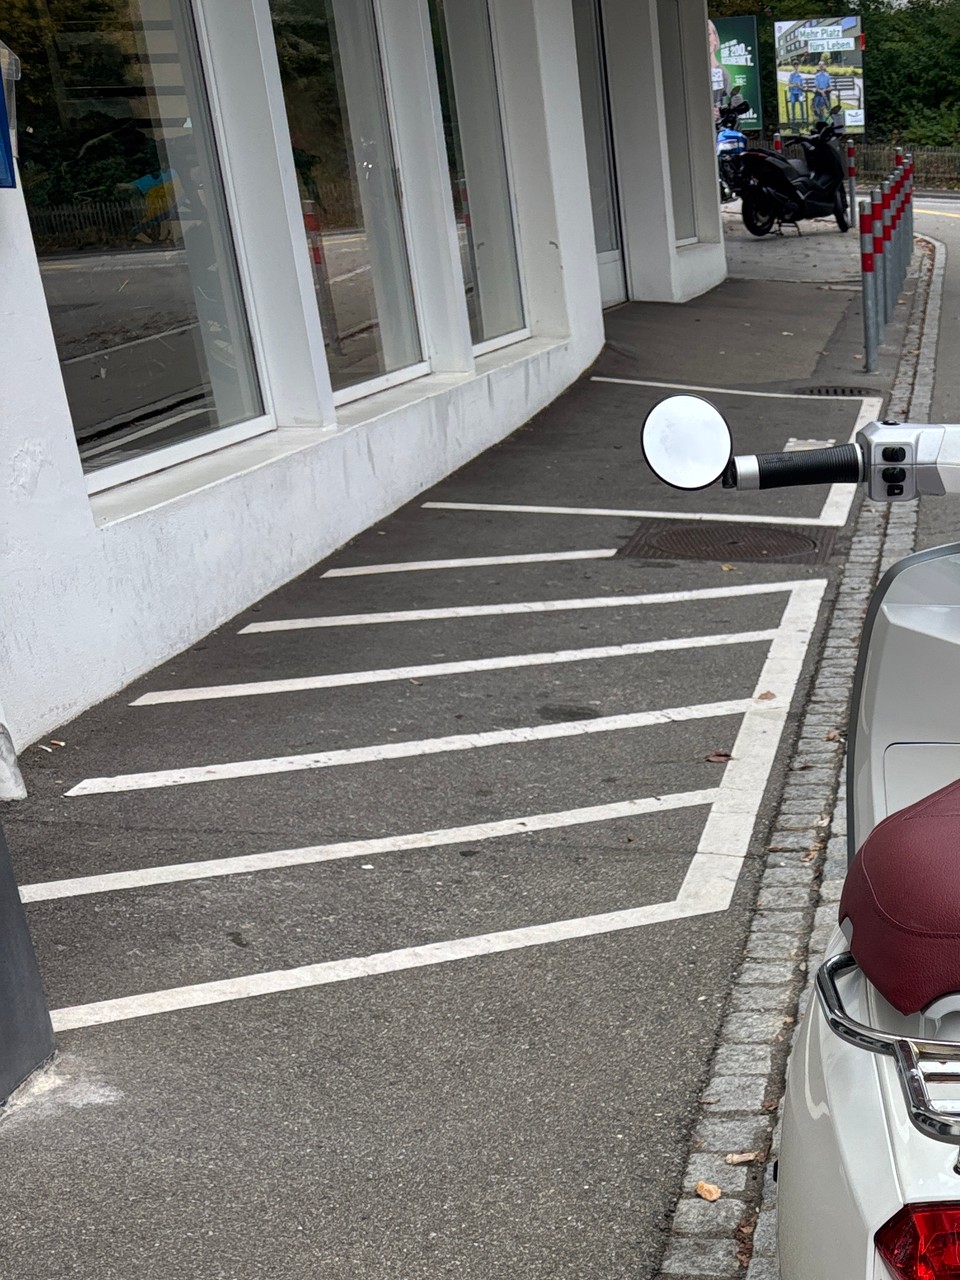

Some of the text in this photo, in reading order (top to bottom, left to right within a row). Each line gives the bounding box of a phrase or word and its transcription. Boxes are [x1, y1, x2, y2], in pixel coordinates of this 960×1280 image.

[800, 27, 841, 38] Mehr Platz
[810, 41, 825, 51] fürs
